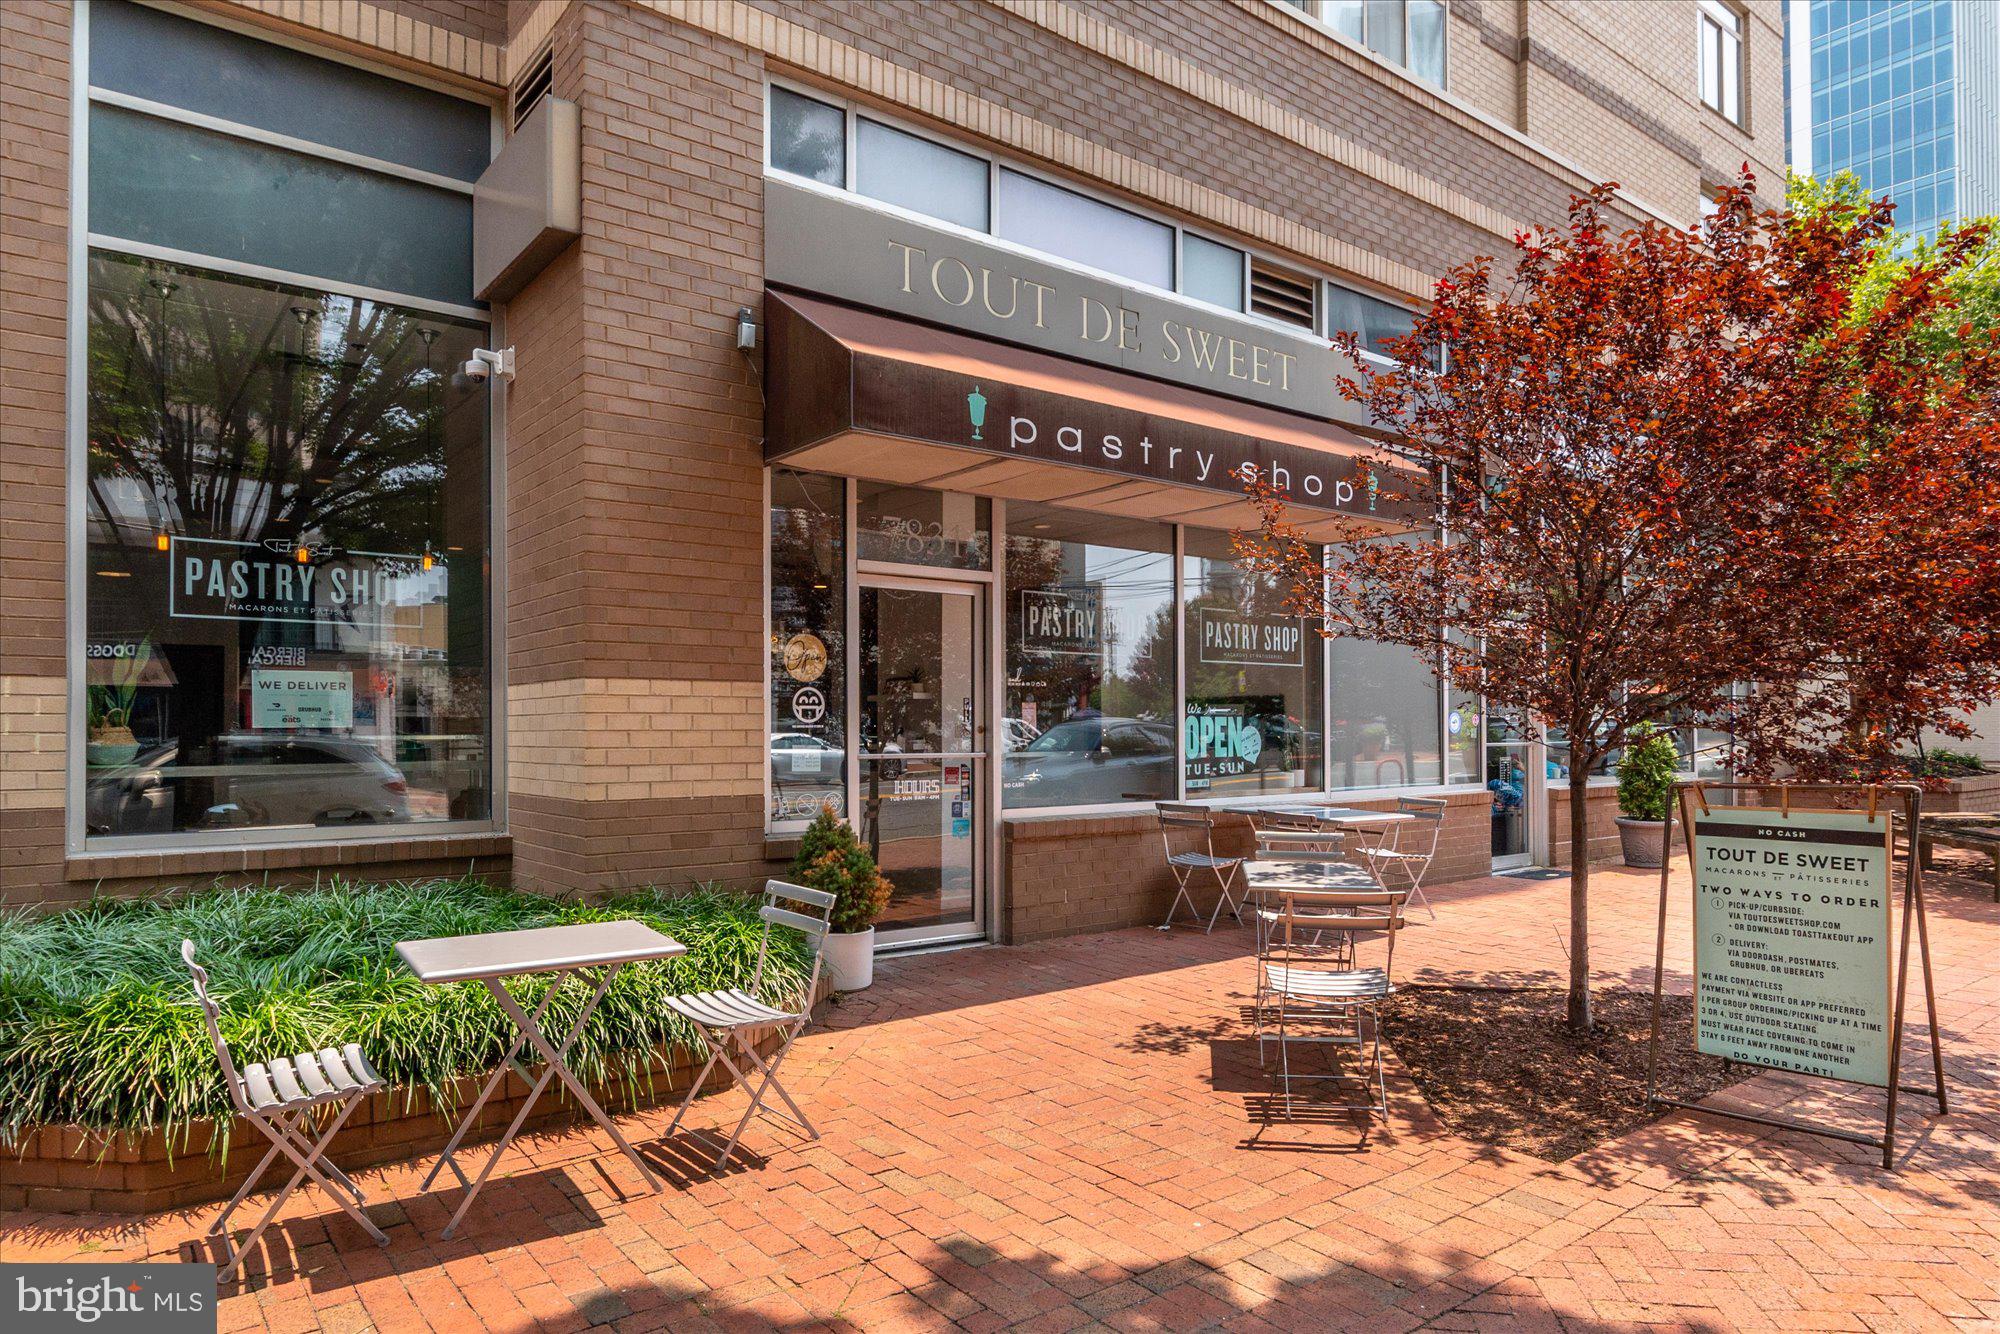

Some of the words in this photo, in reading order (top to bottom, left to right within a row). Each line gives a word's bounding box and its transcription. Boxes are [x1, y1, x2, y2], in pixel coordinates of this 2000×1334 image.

[888, 239, 1056, 330] TOUT
[1079, 296, 1142, 353] DE
[1162, 320, 1298, 391] SWEET
[1010, 415, 1214, 481] pastry
[1241, 460, 1354, 506] shop
[882, 515, 962, 558] 7831
[185, 556, 315, 602] PASTRY
[331, 567, 394, 607] SHO
[229, 603, 289, 614] MACARONS
[1029, 605, 1096, 639] PASTRY
[1206, 621, 1258, 650] PASTRY
[1264, 625, 1299, 652] SHOP
[787, 640, 826, 671] Open
[259, 681, 282, 690] WE
[287, 681, 347, 690] DELIVER
[1185, 715, 1243, 760] OPEN
[1186, 762, 1245, 776] TUE-SUN
[894, 779, 940, 794] HOURS
[1777, 830, 1806, 839] CASH
[1706, 847, 1757, 863] TOUT
[1764, 851, 1790, 866] DE
[1797, 854, 1869, 872] SWEET
[1705, 866, 1767, 878] MACARONS
[1701, 885, 1732, 896] TWO
[1740, 888, 1783, 900] WAYS
[1791, 892, 1812, 902] TO
[1821, 895, 1880, 908] ORDER
[1728, 901, 1805, 916] PICK-UP/CURBSIDE:
[1729, 912, 1741, 920] VIA
[1730, 939, 1768, 950] DELIVERY:
[1734, 923, 1745, 931] OR
[1747, 924, 1790, 936] DOWNLOAD
[1792, 929, 1855, 943] TOASTTAKEOUT
[1857, 936, 1874, 945] APP
[1728, 949, 1739, 957] VIA
[1789, 956, 1839, 970] POSTMATES,
[1702, 972, 1712, 980] WE
[1714, 974, 1728, 982] ARE
[1731, 977, 1783, 991] CONTACTLESS
[1771, 965, 1782, 973] OR
[1784, 967, 1825, 979] UBEREATS
[1701, 984, 1735, 995] PAYMENT
[1737, 989, 1749, 998] VIA
[1752, 992, 1785, 1003] WEBSITE
[1788, 997, 1798, 1005] OR
[1801, 1000, 1816, 1008] APP
[1819, 1002, 1866, 1016] PREFERRED
[1707, 996, 1720, 1004] PER
[1723, 999, 1747, 1009] GROUP
[1750, 1003, 1824, 1022] ORDERING/PICKING
[1827, 1016, 1838, 1024] UP
[1841, 1018, 1850, 1026] AT
[1861, 1022, 1882, 1032] TIME
[1708, 1008, 1718, 1016] OR
[1729, 1012, 1743, 1021] USE
[1745, 1015, 1781, 1027] OUTDOOR
[1701, 1019, 1721, 1028] MUST
[1723, 1023, 1743, 1033] WEAR
[1746, 1027, 1764, 1037] FACE
[1767, 1031, 1806, 1044] COVERING
[1808, 1038, 1818, 1047] TO
[1821, 1041, 1843, 1051] COME
[1846, 1045, 1855, 1053] IN
[1701, 1031, 1719, 1040] STAY
[1727, 1036, 1745, 1045] FEET
[1747, 1040, 1767, 1050] AWAY
[1770, 1043, 1791, 1055] FROM
[1794, 1046, 1809, 1057] ONE
[1812, 1051, 1850, 1065] ANOTHER
[1734, 1051, 1748, 1060] DO
[1755, 1055, 1788, 1068] YOUR
[1795, 1063, 1834, 1077] PART!
